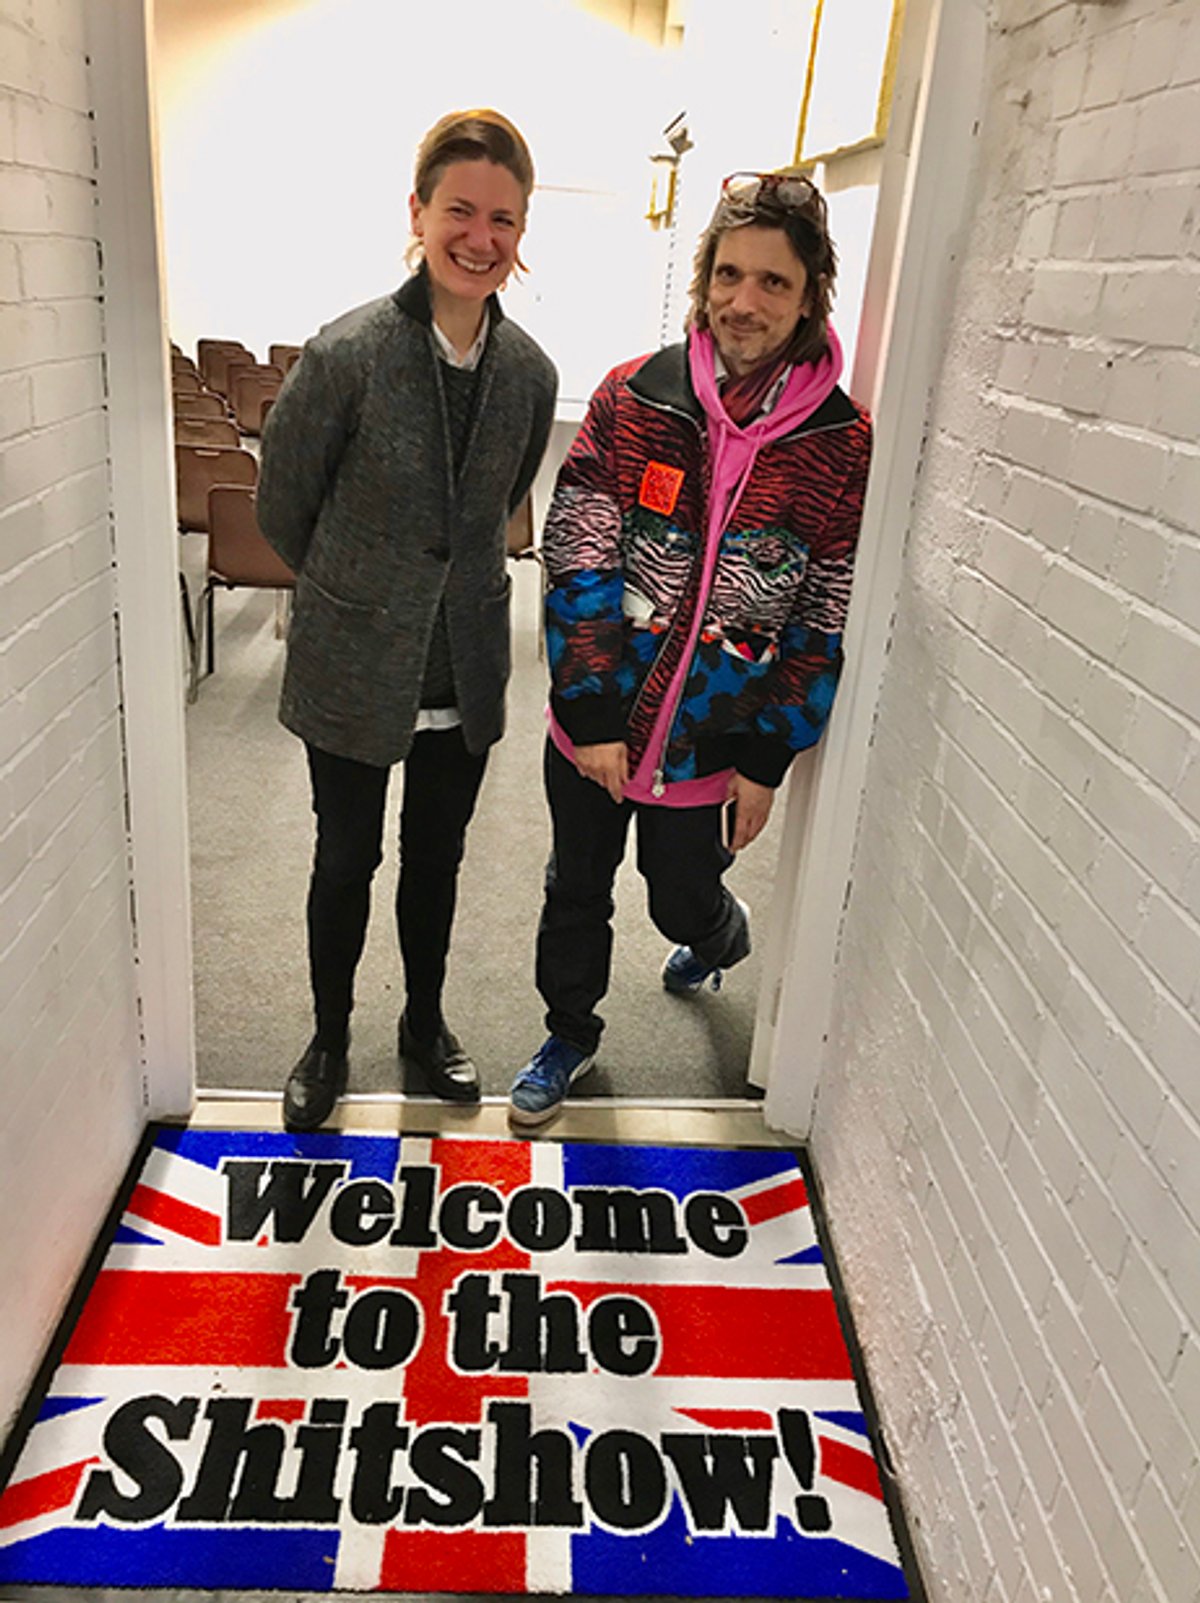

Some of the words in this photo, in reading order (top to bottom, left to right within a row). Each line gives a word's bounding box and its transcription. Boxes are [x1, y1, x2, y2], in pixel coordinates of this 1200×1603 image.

[221, 1160, 749, 1258] Welcome
[290, 1269, 419, 1370] to
[447, 1273, 659, 1376] the
[74, 1395, 832, 1532] Shitshow!
